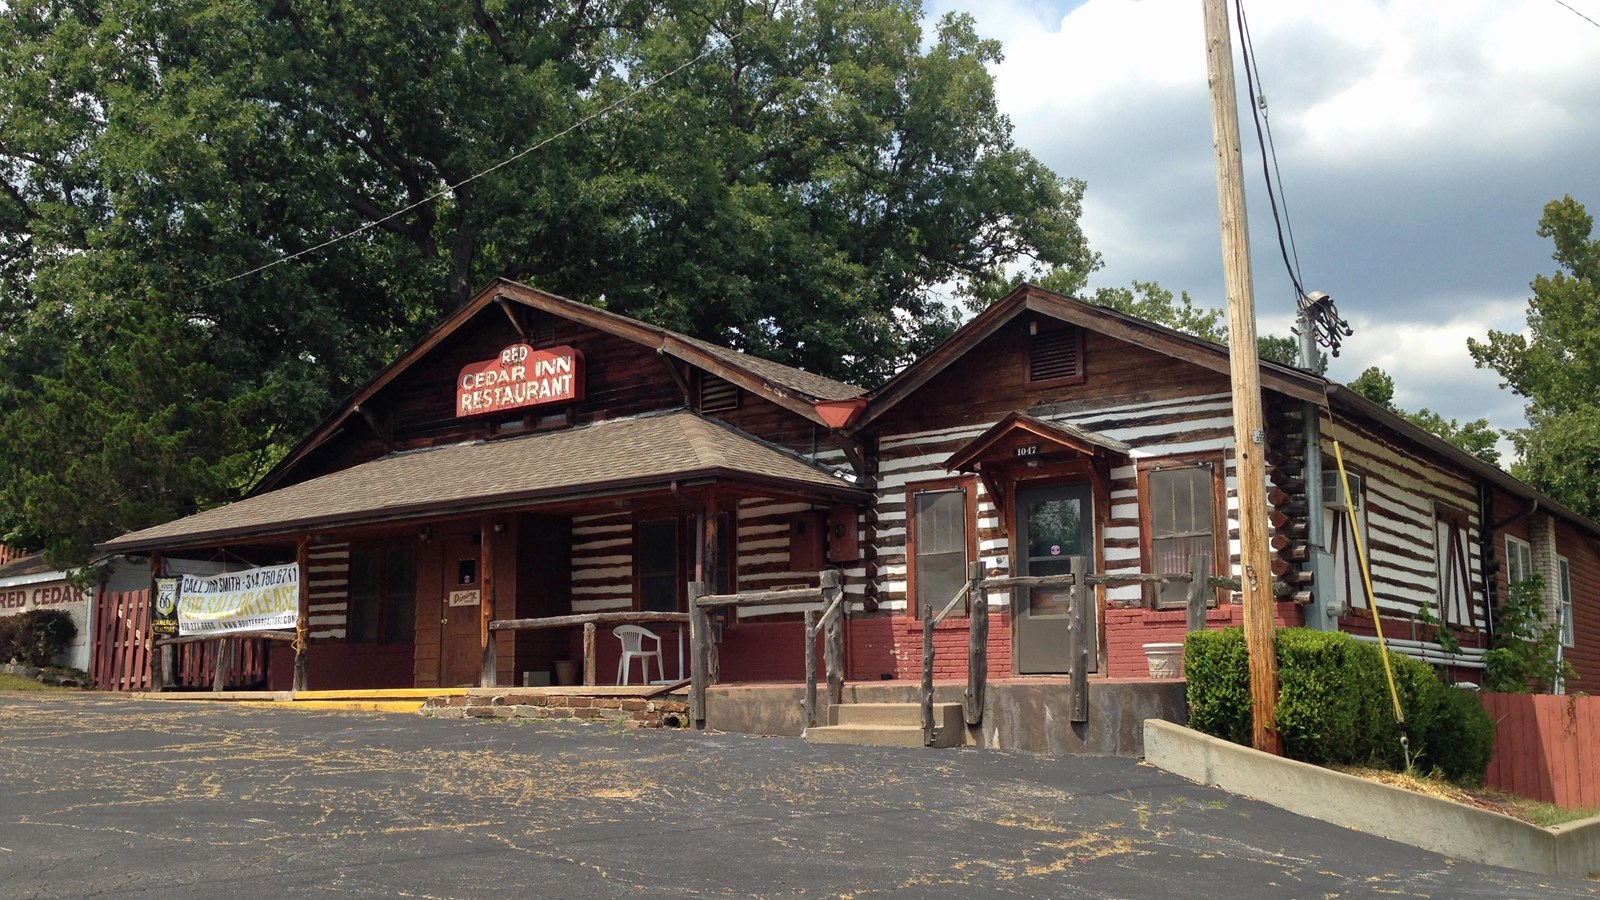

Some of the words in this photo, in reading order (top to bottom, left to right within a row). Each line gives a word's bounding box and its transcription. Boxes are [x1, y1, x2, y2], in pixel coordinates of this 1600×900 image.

[501, 346, 528, 364] RED
[462, 366, 526, 390] CEDAR
[535, 355, 571, 377] INN
[461, 374, 572, 411] RESTAURANT
[1017, 446, 1036, 456] 1047
[183, 579, 203, 593] CALL
[219, 576, 240, 592] SMITH
[0, 590, 26, 608] RED
[33, 586, 84, 606] CEDAR
[159, 592, 172, 609] 66
[255, 585, 297, 614] LEASE
